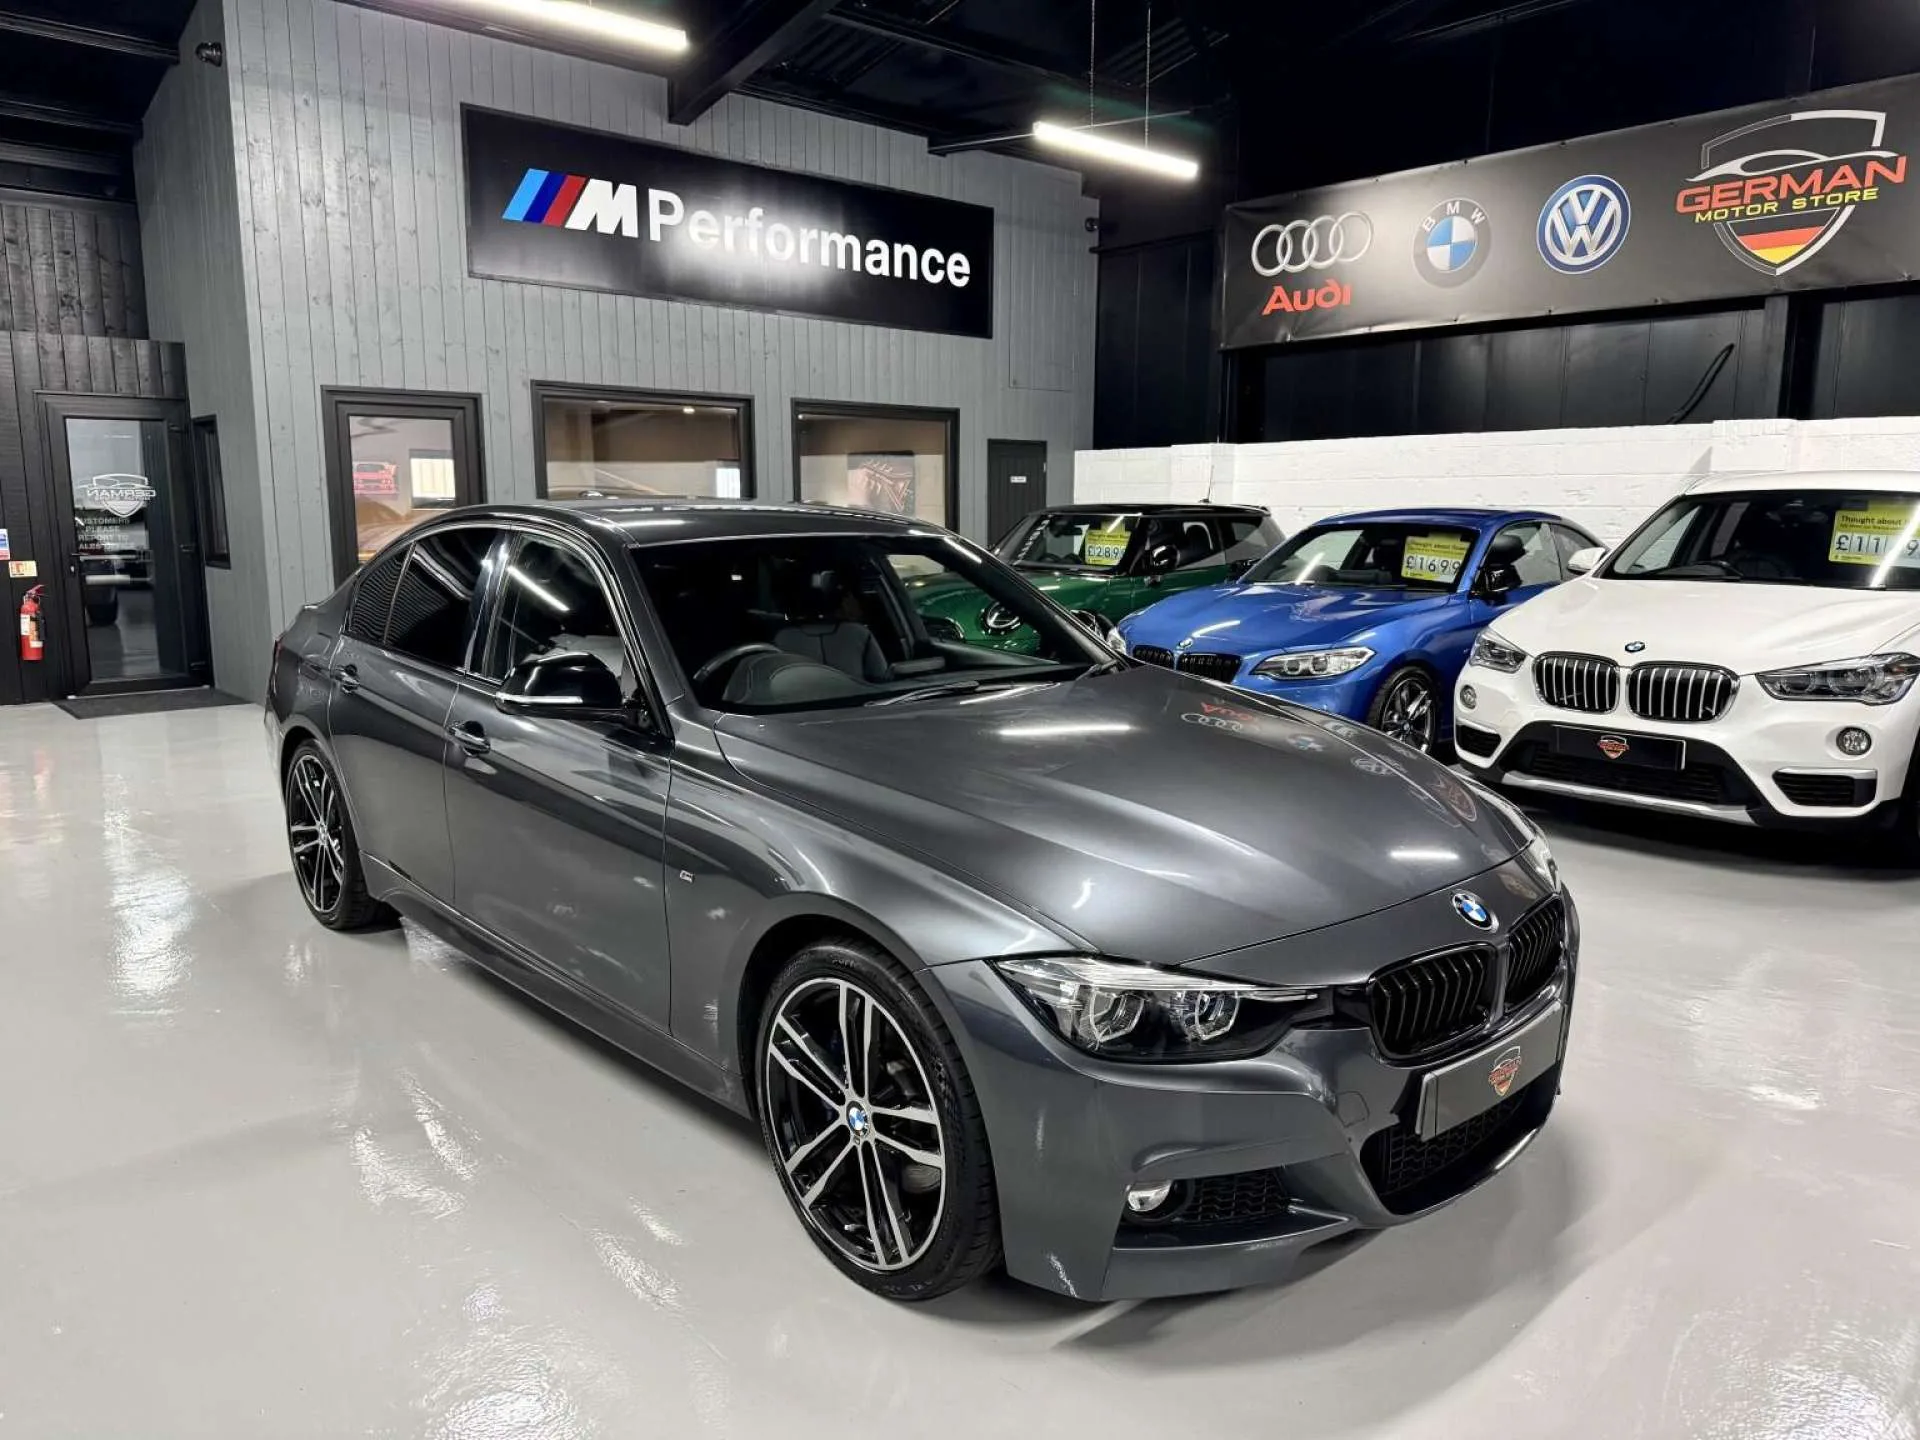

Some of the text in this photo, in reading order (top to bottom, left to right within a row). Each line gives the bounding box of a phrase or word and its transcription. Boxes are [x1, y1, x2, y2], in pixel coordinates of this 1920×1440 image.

[1676, 155, 1907, 213] GERMAN
[1422, 201, 1485, 232] BMW
[1695, 187, 1879, 223] MOTOR STORE
[648, 189, 971, 287] Performance
[1262, 279, 1353, 316] Audi
[1835, 534, 1920, 557] £119
